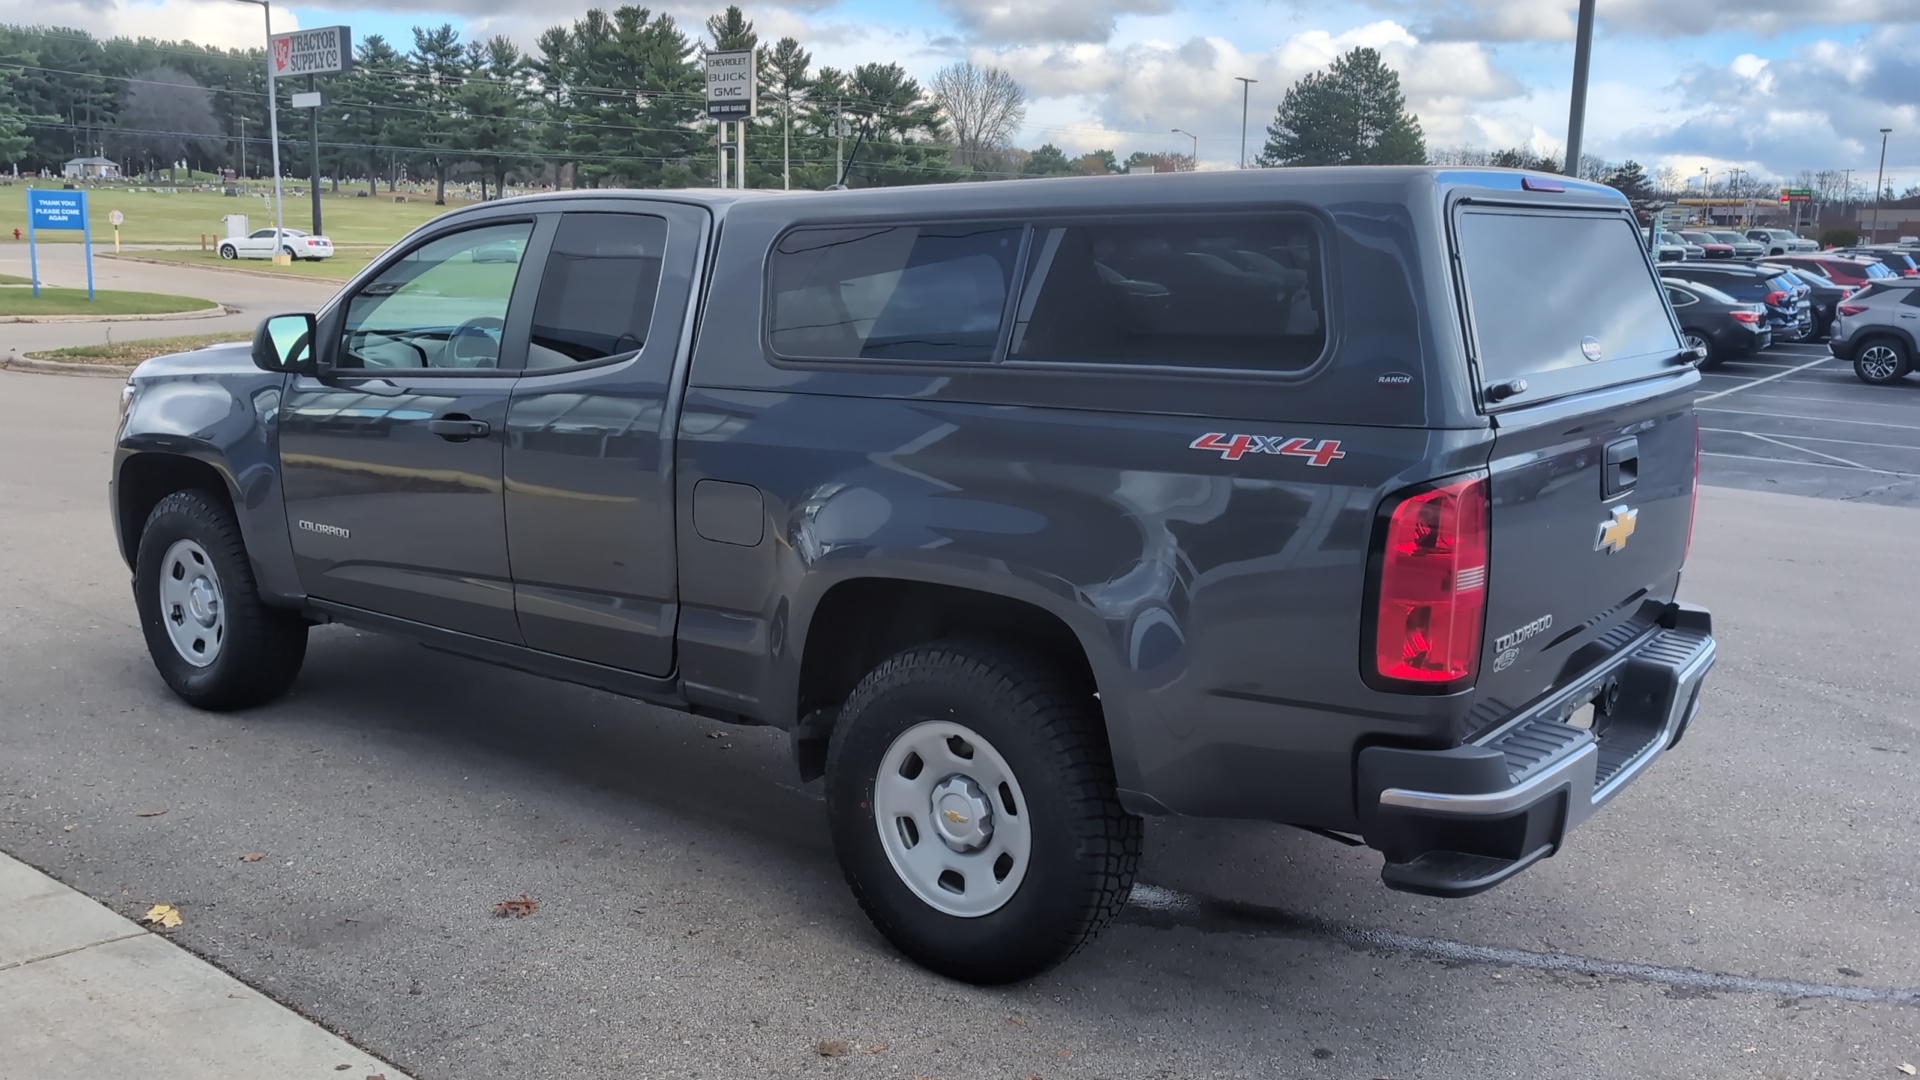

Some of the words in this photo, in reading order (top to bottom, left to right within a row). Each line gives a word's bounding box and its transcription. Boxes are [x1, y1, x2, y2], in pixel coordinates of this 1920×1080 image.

[290, 31, 336, 53] TRACTOR
[290, 51, 325, 72] SUPPLY
[708, 57, 747, 67] CHEVROLET
[709, 72, 747, 82] BUICK
[714, 87, 742, 96] GMC
[299, 519, 350, 539] COLORADO
[1494, 614, 1553, 653] COLORADO
